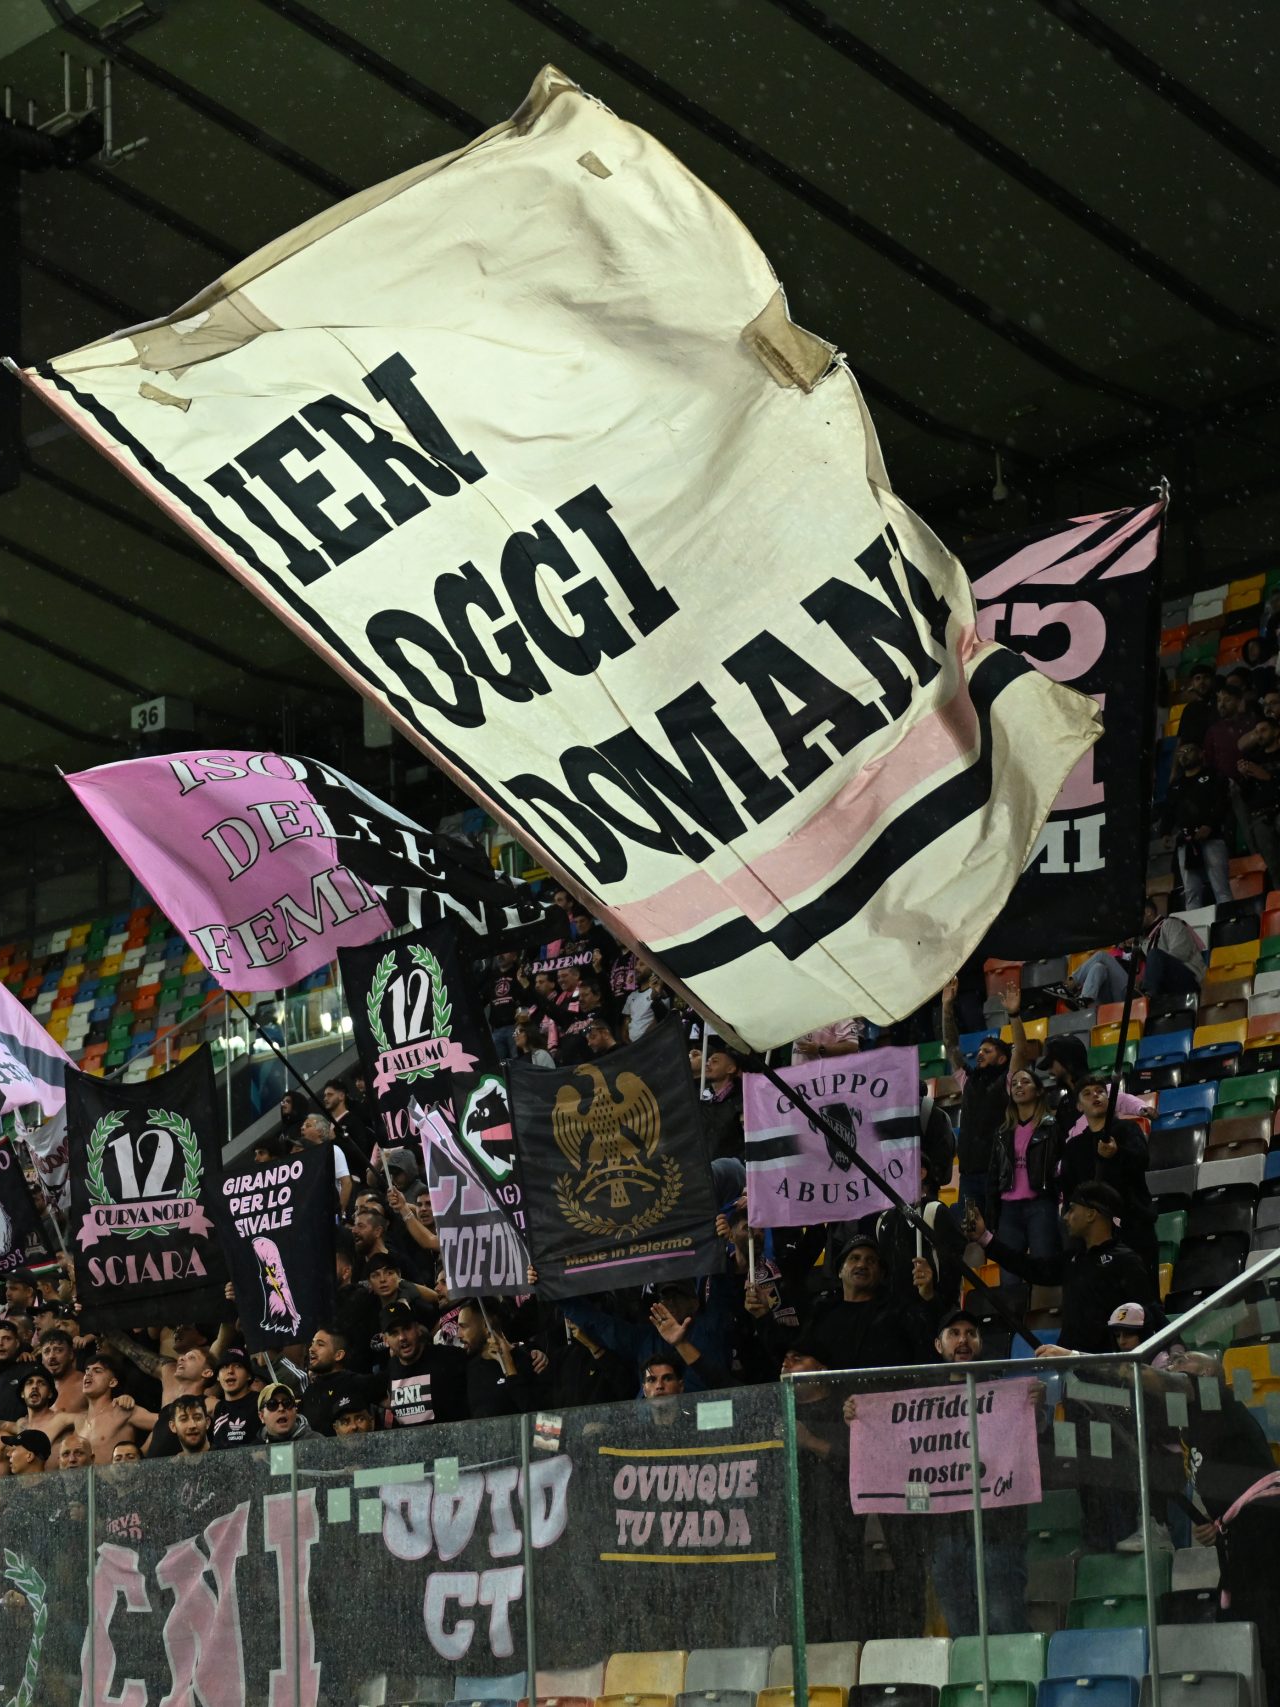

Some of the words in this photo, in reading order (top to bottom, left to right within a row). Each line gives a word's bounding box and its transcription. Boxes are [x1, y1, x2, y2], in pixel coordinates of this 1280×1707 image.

[203, 351, 488, 587] IERI
[365, 483, 680, 729] OGGI
[137, 705, 159, 730] 36
[531, 950, 594, 975] PALERMO
[387, 968, 431, 1045] 12
[381, 1039, 450, 1074] PALERMO
[775, 1072, 890, 1115] GRUPPO
[107, 1128, 178, 1200] 12
[222, 1159, 304, 1197] GIRANDO
[94, 1206, 151, 1226] CURVA
[152, 1201, 195, 1222] NORD
[229, 1192, 264, 1217] PER
[266, 1186, 293, 1210] LO
[86, 1247, 208, 1288] SCIARA
[565, 1249, 608, 1267] Made
[611, 1246, 626, 1258] in
[629, 1235, 694, 1257] Palermo
[393, 1383, 422, 1406] CNI
[395, 1404, 426, 1418] PALERMO
[612, 1458, 759, 1506] OVUNQUE
[615, 1508, 659, 1547] TU
[660, 1508, 752, 1548] VADA
[423, 1564, 524, 1660] CT
